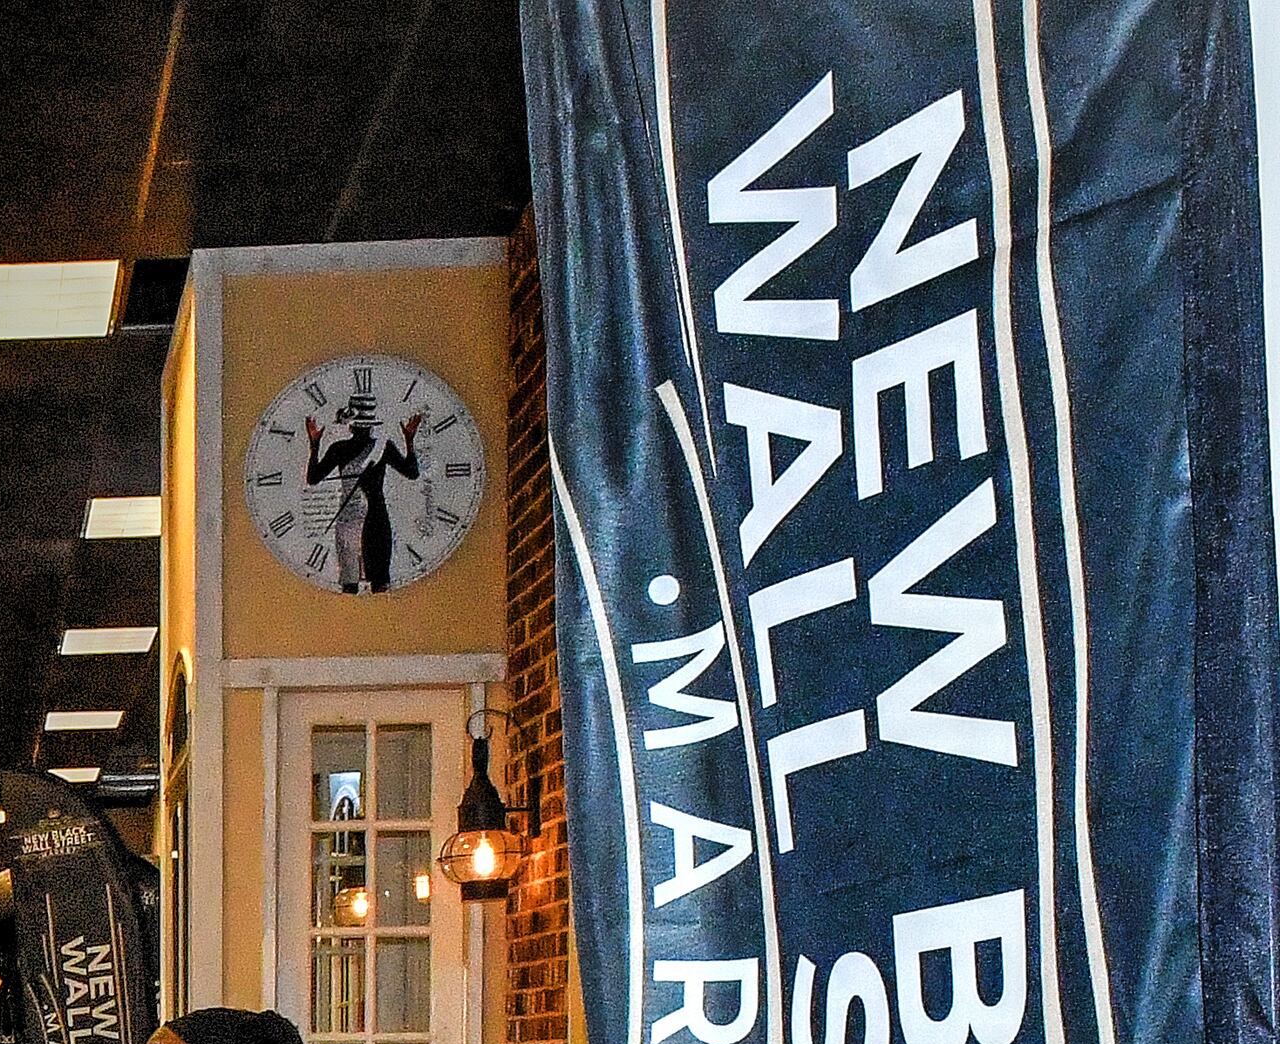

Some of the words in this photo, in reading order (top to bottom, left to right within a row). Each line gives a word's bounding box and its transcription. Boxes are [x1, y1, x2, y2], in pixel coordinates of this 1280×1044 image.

[707, 70, 868, 854] WALL
[847, 90, 1019, 767] NEW
[21, 839, 52, 854] WALL
[54, 832, 96, 849] STREET
[23, 831, 49, 845] NEW
[51, 825, 87, 841] BLACK
[86, 943, 120, 1040] NEW
